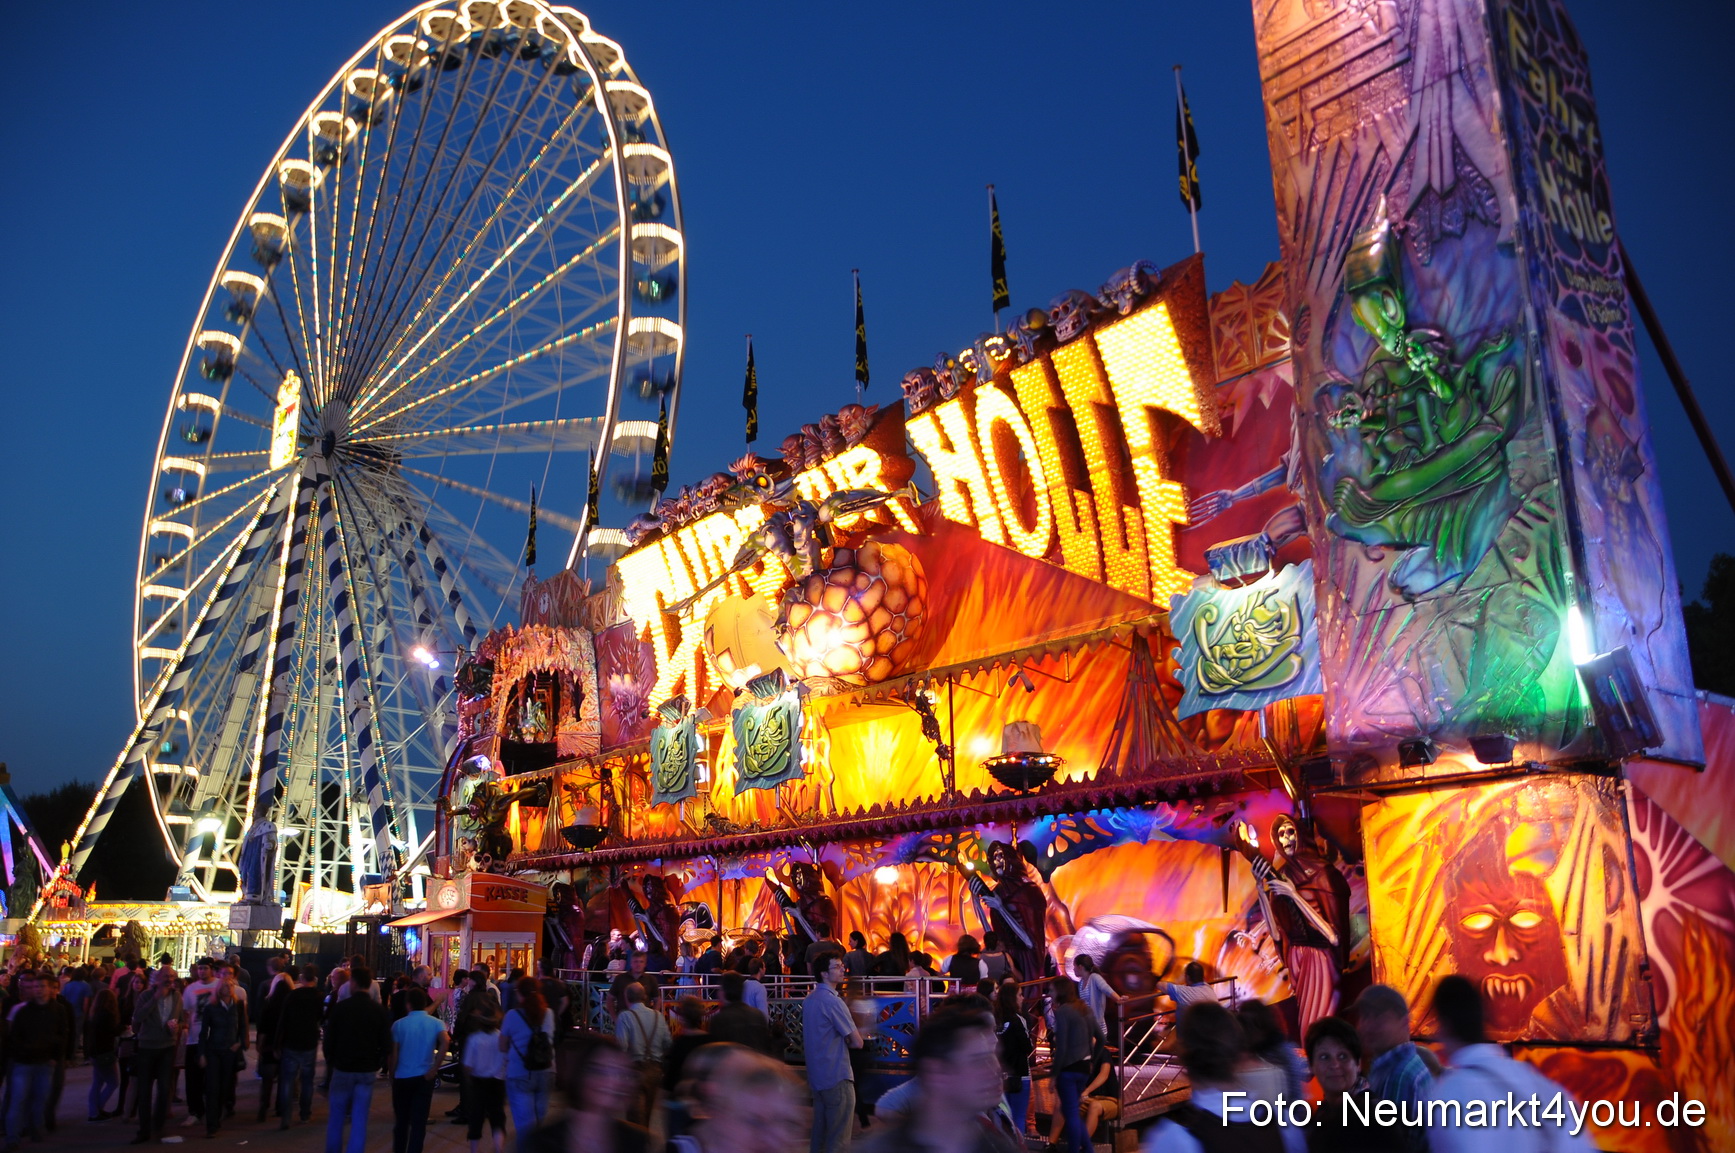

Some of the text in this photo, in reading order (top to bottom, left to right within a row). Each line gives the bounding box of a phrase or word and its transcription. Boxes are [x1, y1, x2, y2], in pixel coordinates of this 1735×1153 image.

[1507, 6, 1598, 157] Fahrt
[1547, 128, 1583, 176] zur
[1534, 150, 1614, 243] Hölle
[485, 886, 528, 903] KASSE
